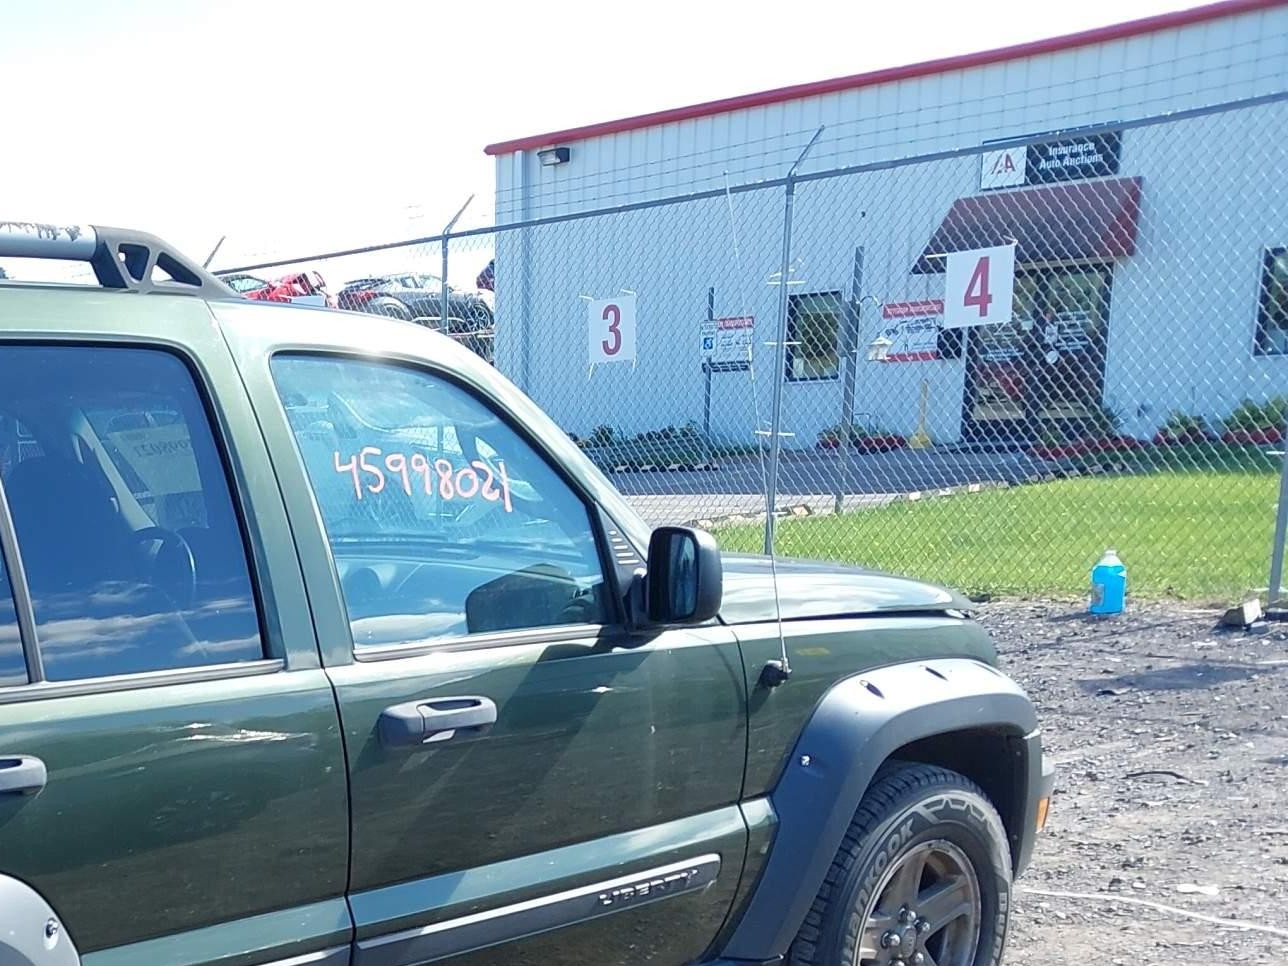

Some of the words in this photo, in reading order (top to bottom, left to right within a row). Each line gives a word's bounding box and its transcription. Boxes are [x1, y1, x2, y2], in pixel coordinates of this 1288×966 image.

[1038, 158, 1062, 170] Auto
[1062, 154, 1104, 167] Auctions
[1047, 142, 1096, 156] Insurance
[963, 256, 993, 317] 4
[602, 304, 623, 356] 3
[333, 447, 513, 513] 45998021
